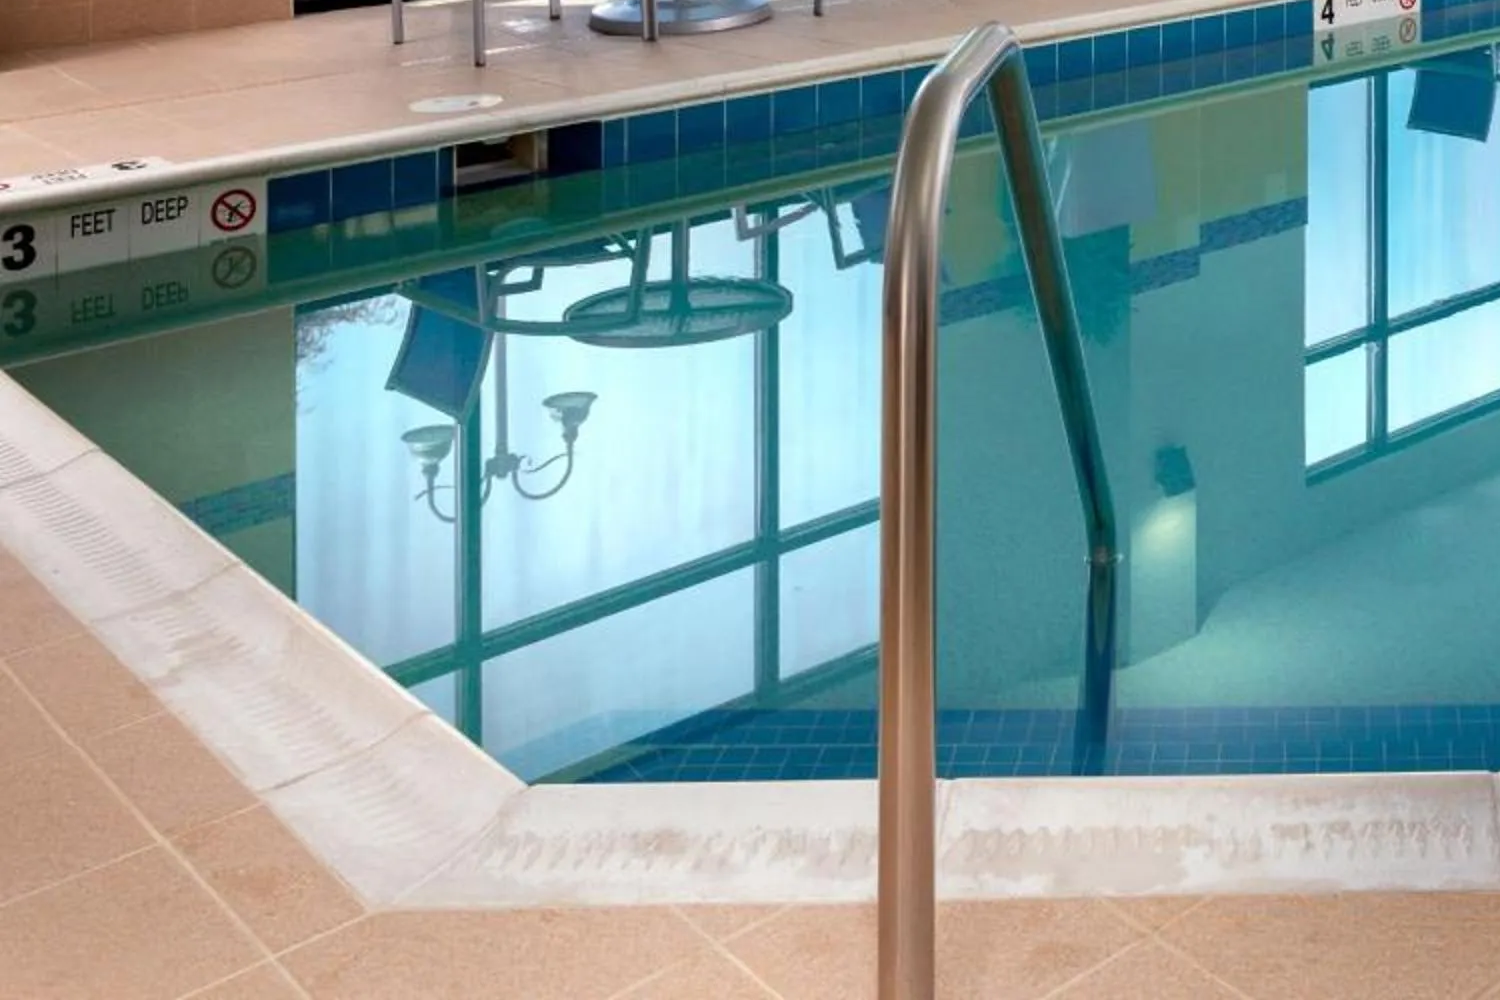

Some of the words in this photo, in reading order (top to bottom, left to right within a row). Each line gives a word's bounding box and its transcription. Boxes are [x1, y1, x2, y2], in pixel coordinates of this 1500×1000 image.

[2, 224, 36, 271] 3
[71, 208, 116, 238] FEET
[141, 196, 188, 225] DEEP
